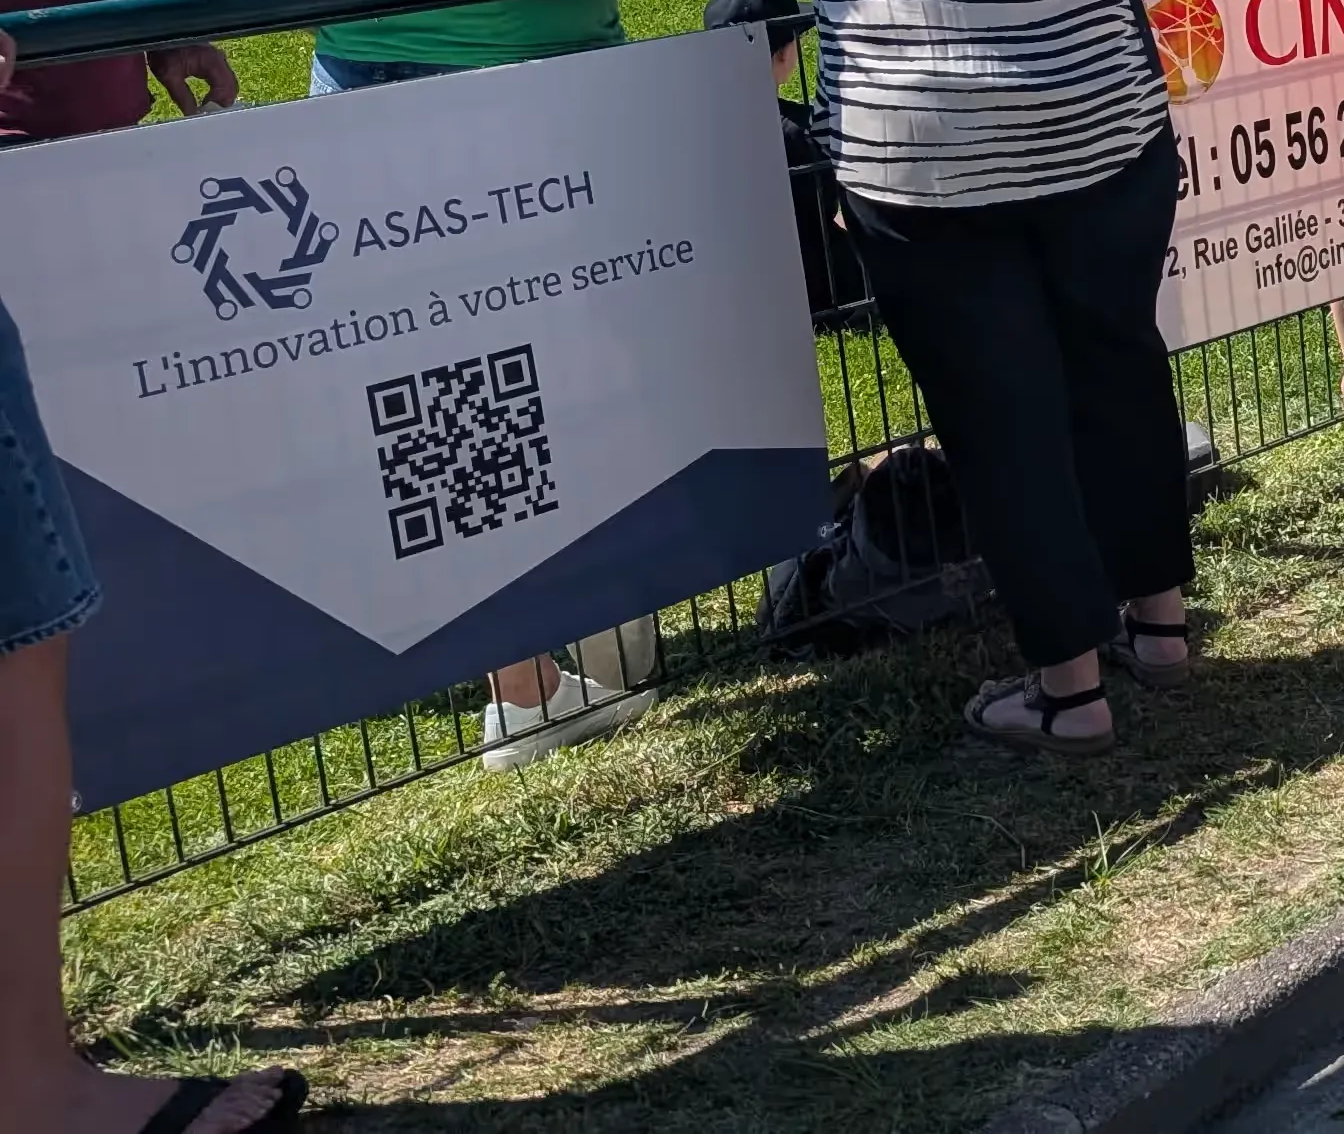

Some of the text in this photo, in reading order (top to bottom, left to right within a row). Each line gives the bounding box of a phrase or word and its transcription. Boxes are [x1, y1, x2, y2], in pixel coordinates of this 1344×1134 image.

[1230, 118, 1276, 185] 05
[1285, 106, 1329, 171] 56
[351, 170, 596, 257] ASAS-TECH
[1162, 246, 1187, 280] 2,
[1193, 237, 1239, 270] Rue
[1245, 209, 1319, 254] Galilée
[132, 236, 696, 399] L'innovation à votre service
